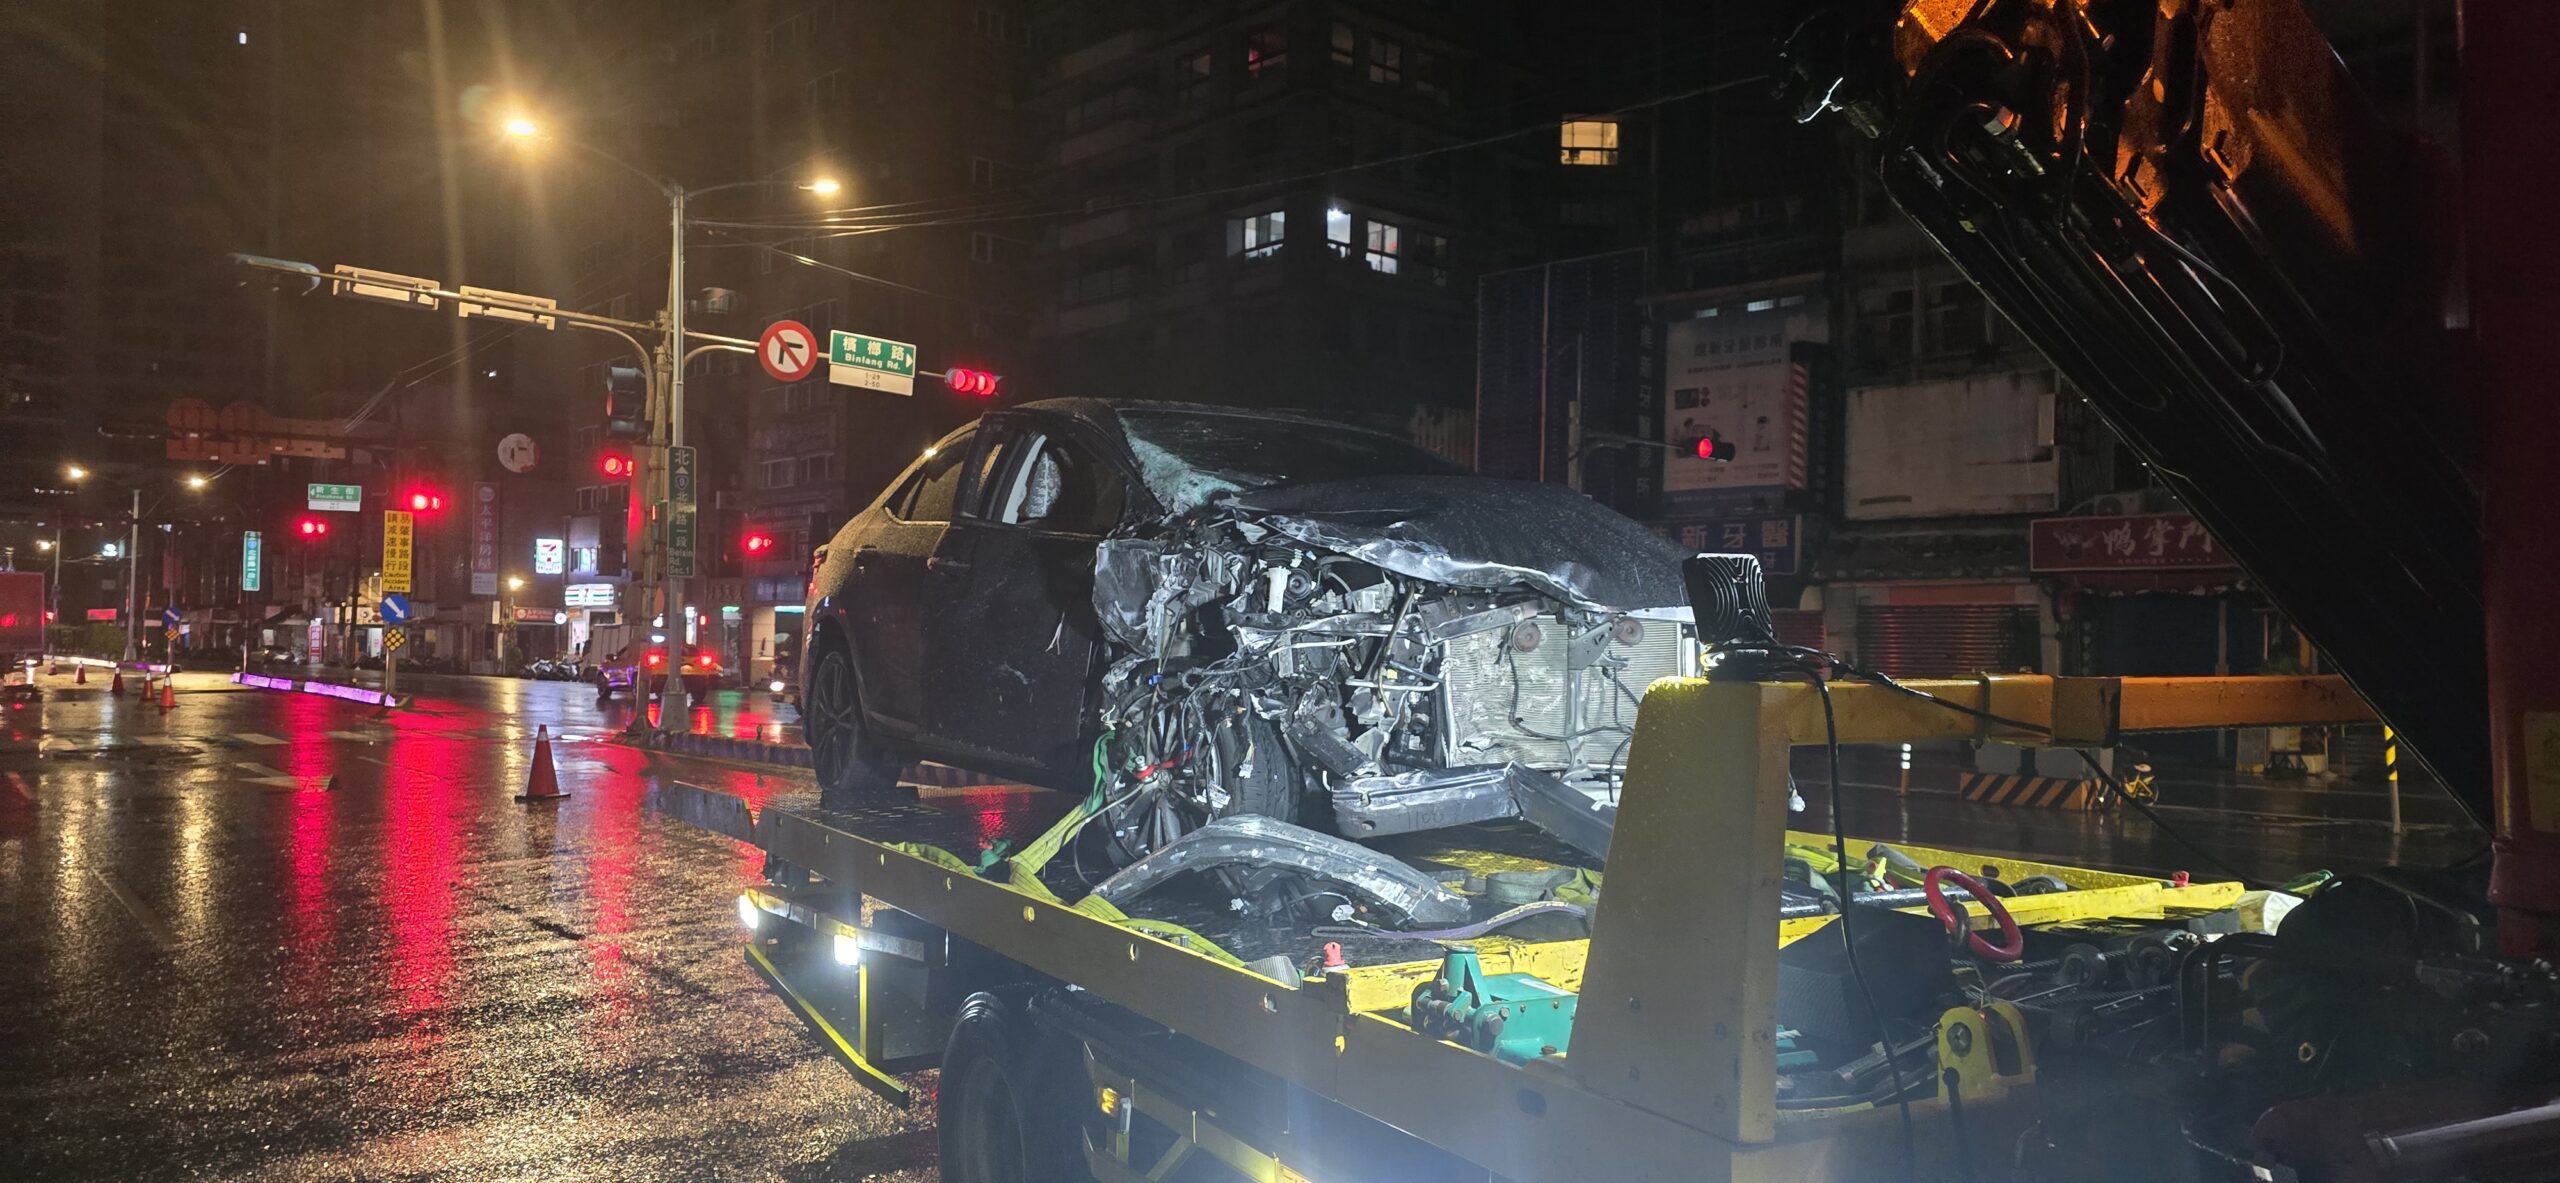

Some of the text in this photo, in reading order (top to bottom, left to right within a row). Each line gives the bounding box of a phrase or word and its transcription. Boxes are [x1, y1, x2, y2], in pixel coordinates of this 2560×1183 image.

[845, 353, 901, 370] Binlang Rd.
[675, 450, 690, 465] 北
[675, 491, 688, 547] 北路一段
[1652, 520, 1788, 550] 新牙醫
[669, 547, 693, 557] Beixin
